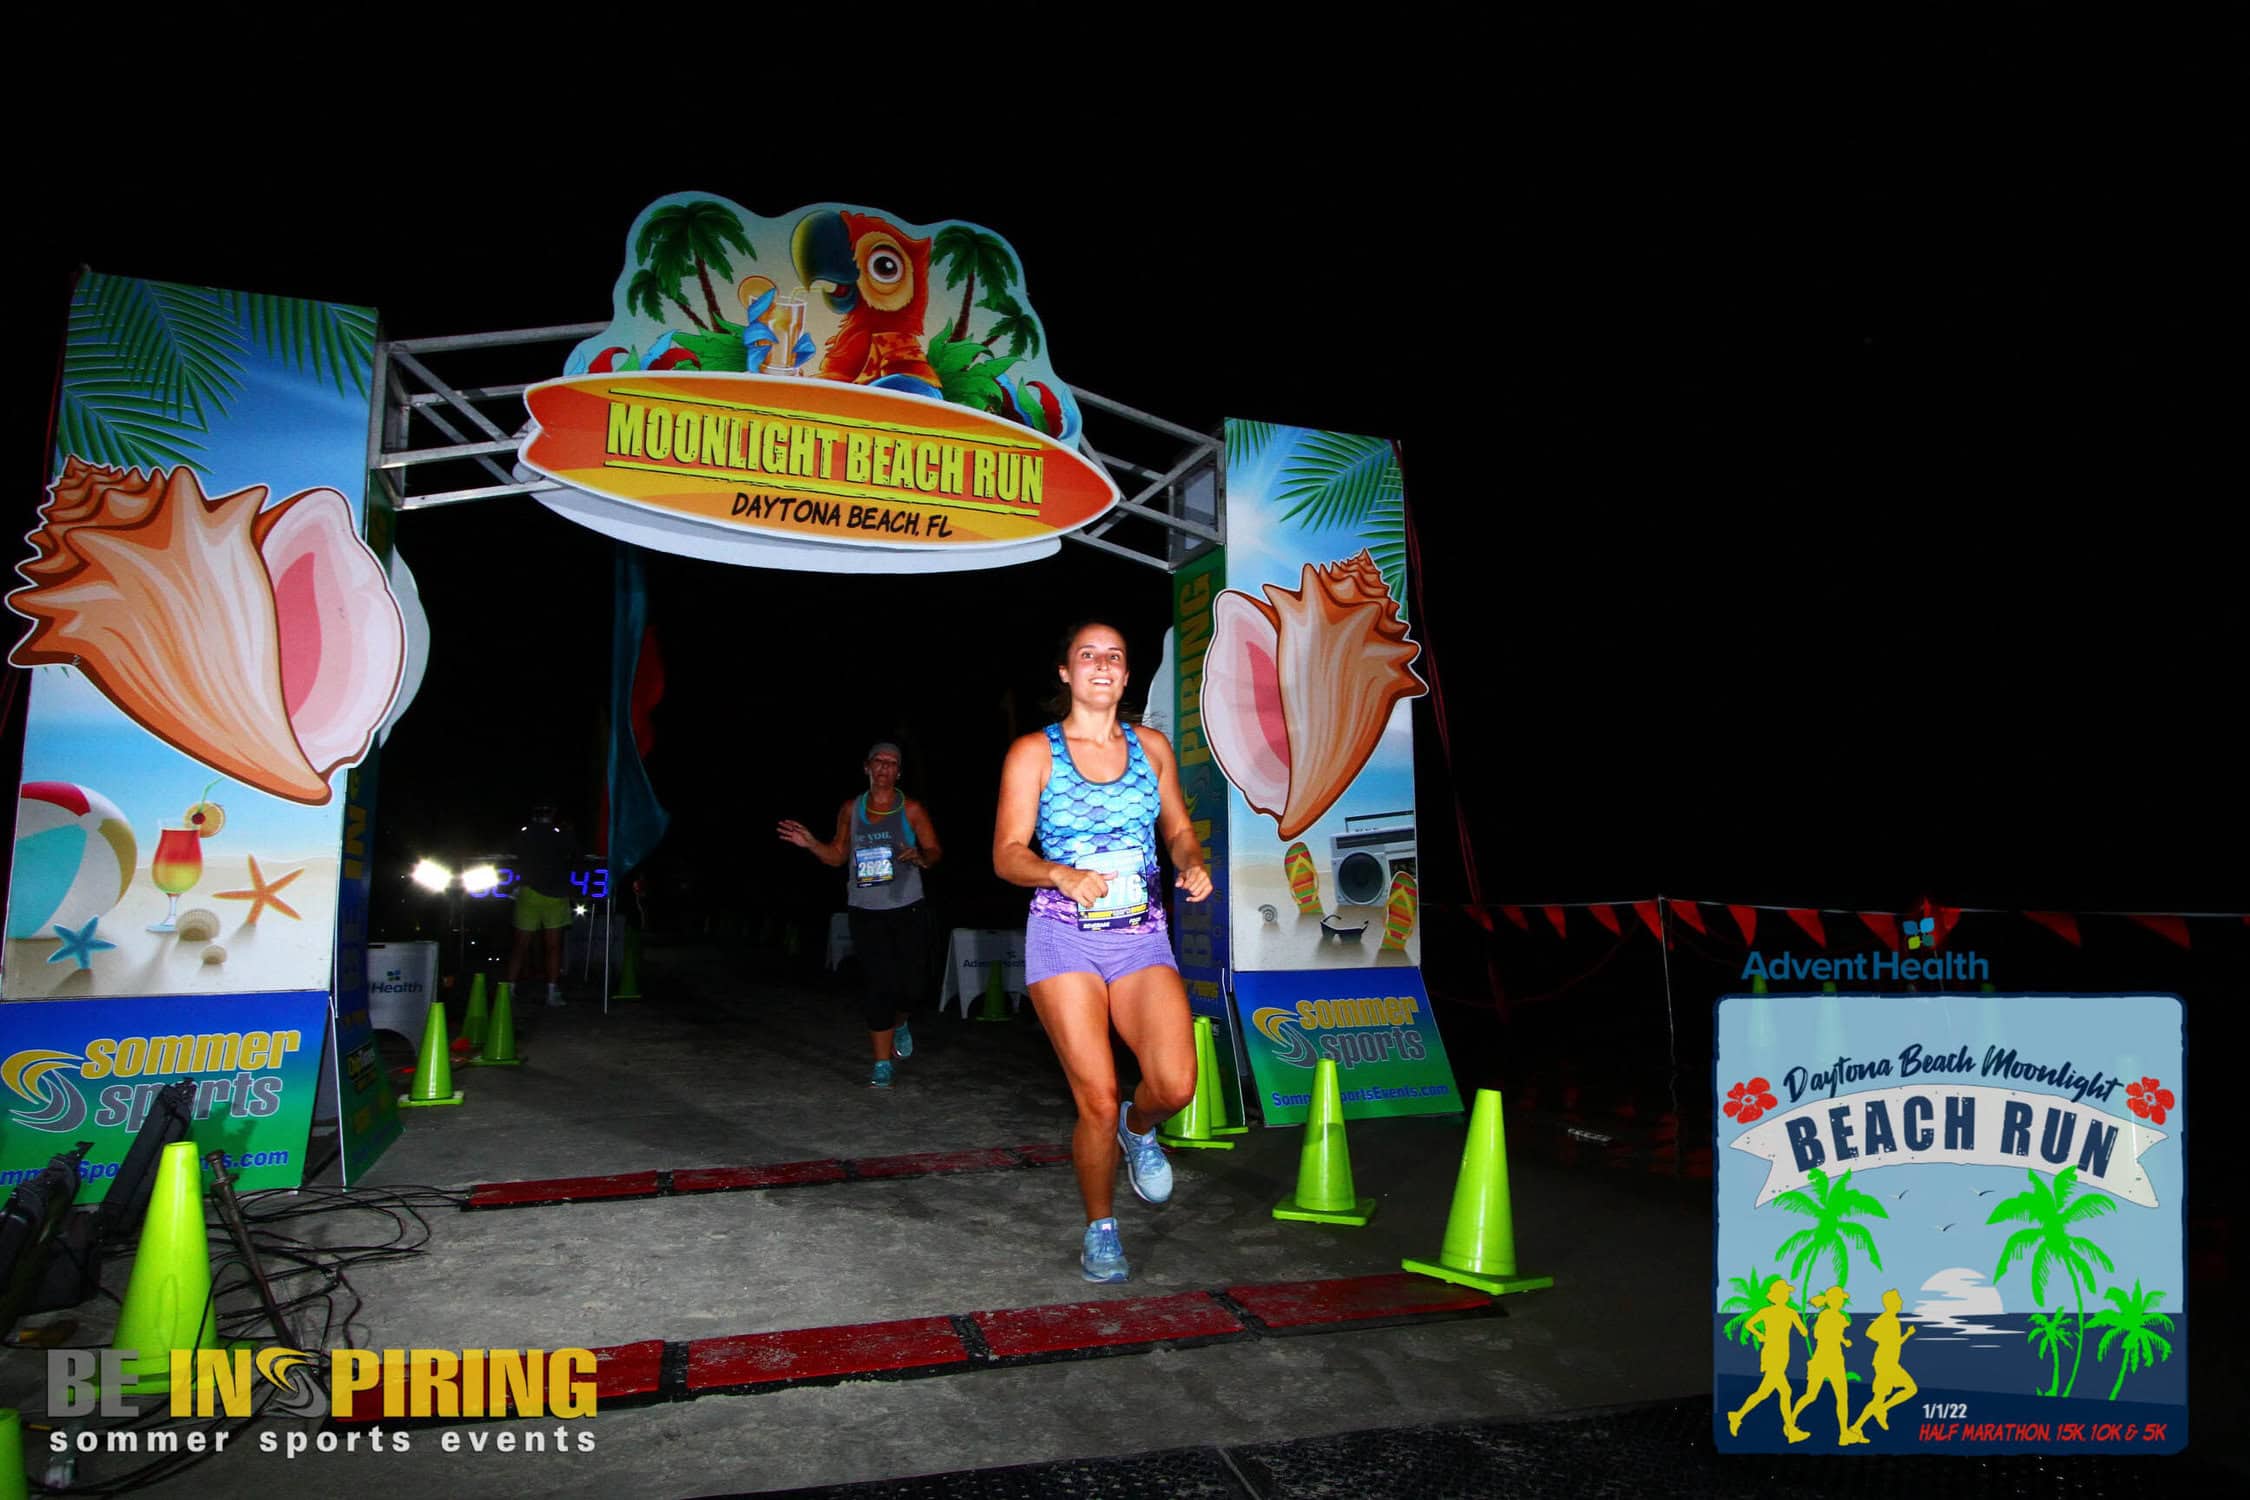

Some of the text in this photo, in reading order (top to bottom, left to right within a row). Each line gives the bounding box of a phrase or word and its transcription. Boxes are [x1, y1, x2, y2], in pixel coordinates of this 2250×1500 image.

[605, 402, 1045, 504] MOONLIGHT BEACH RUN
[731, 492, 841, 527] DAYTONA
[926, 514, 953, 538] FL
[1296, 996, 1419, 1031] sommer
[80, 1030, 302, 1080] sommer
[1319, 1026, 1427, 1070] sports
[95, 1071, 283, 1133] sprts
